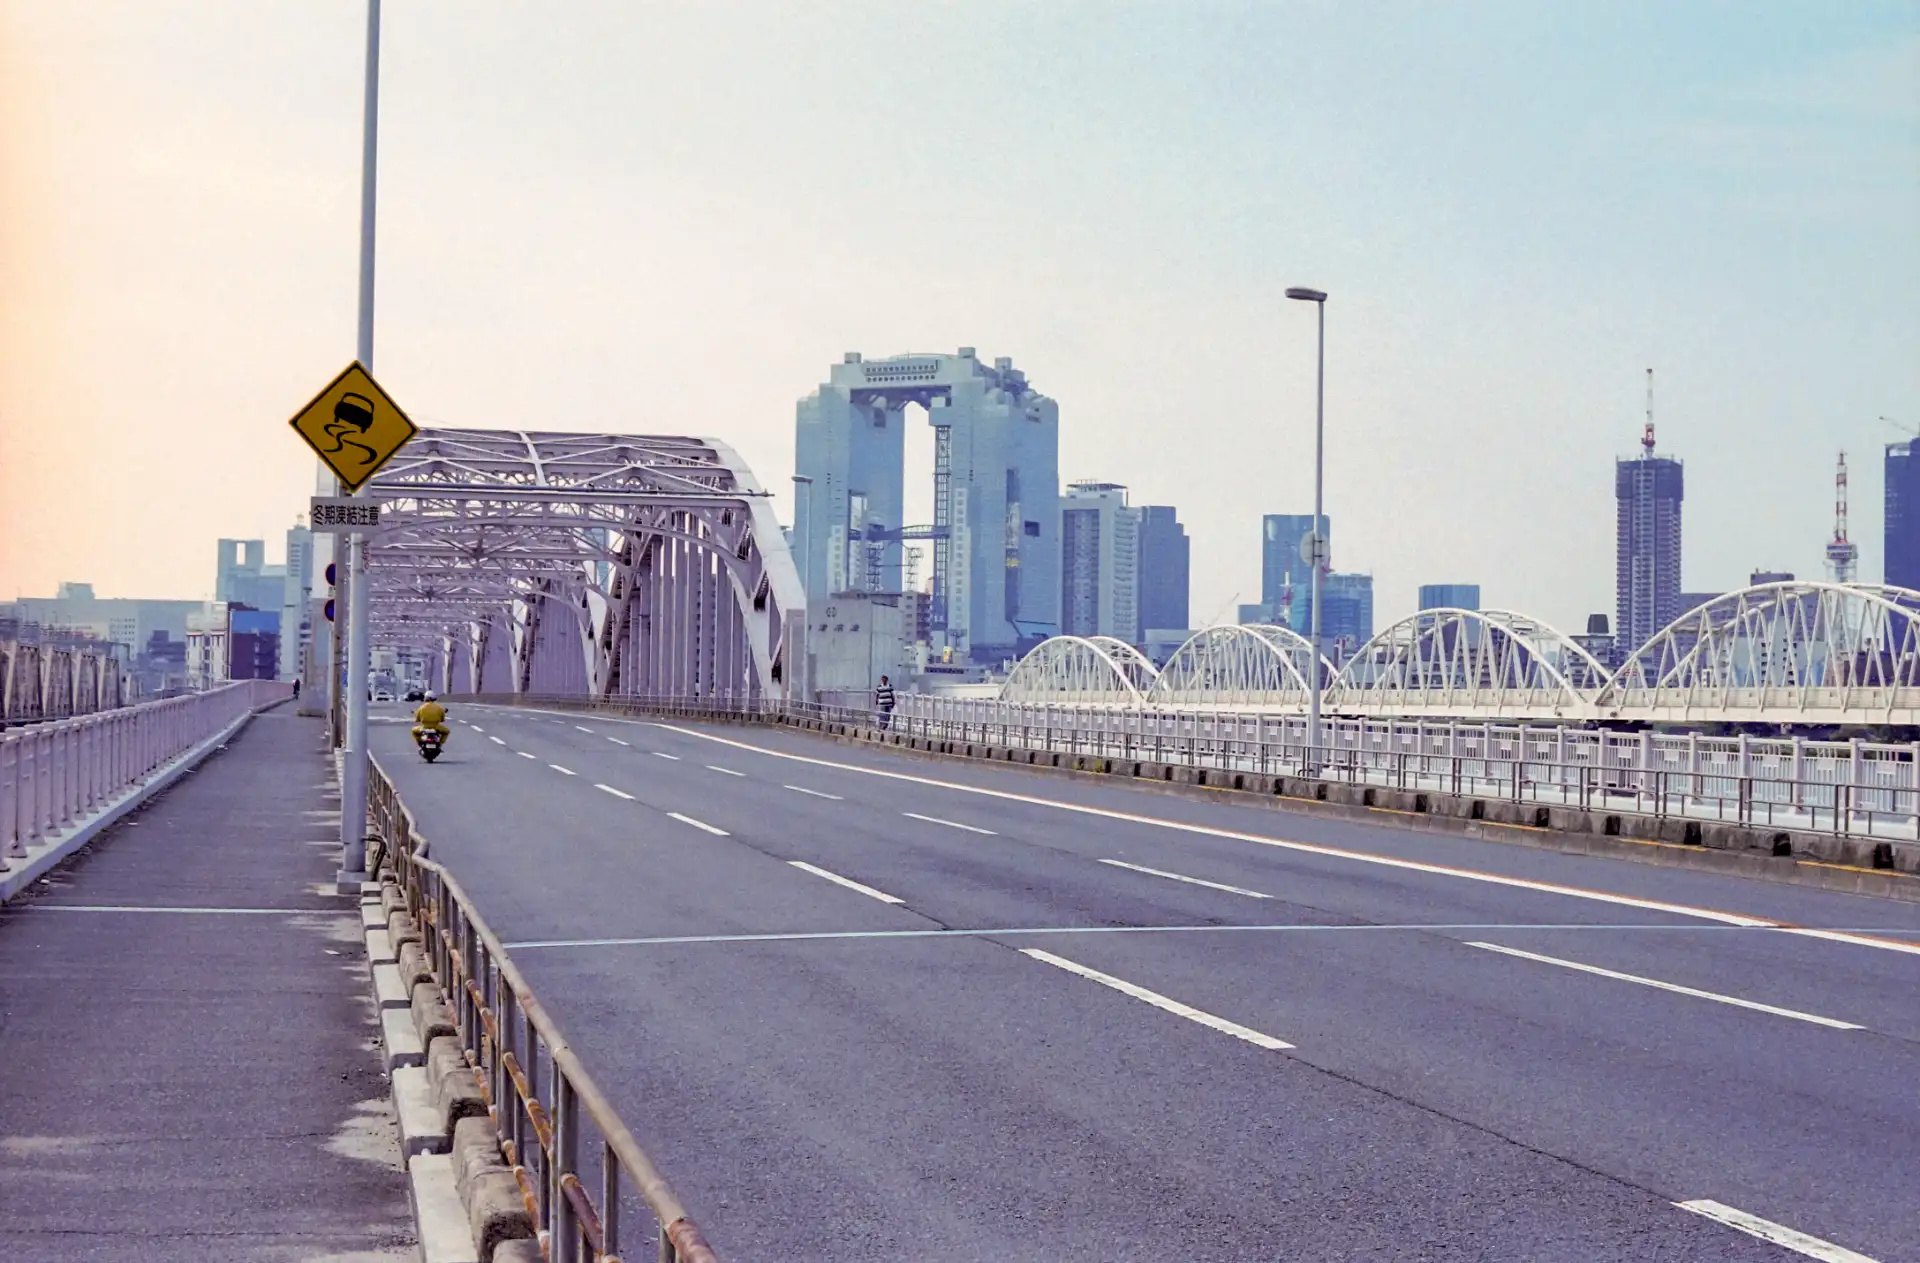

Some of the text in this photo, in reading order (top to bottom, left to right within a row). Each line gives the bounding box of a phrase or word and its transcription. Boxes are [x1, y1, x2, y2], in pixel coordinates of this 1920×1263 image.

[313, 505, 379, 525] 冬期凍結注意
